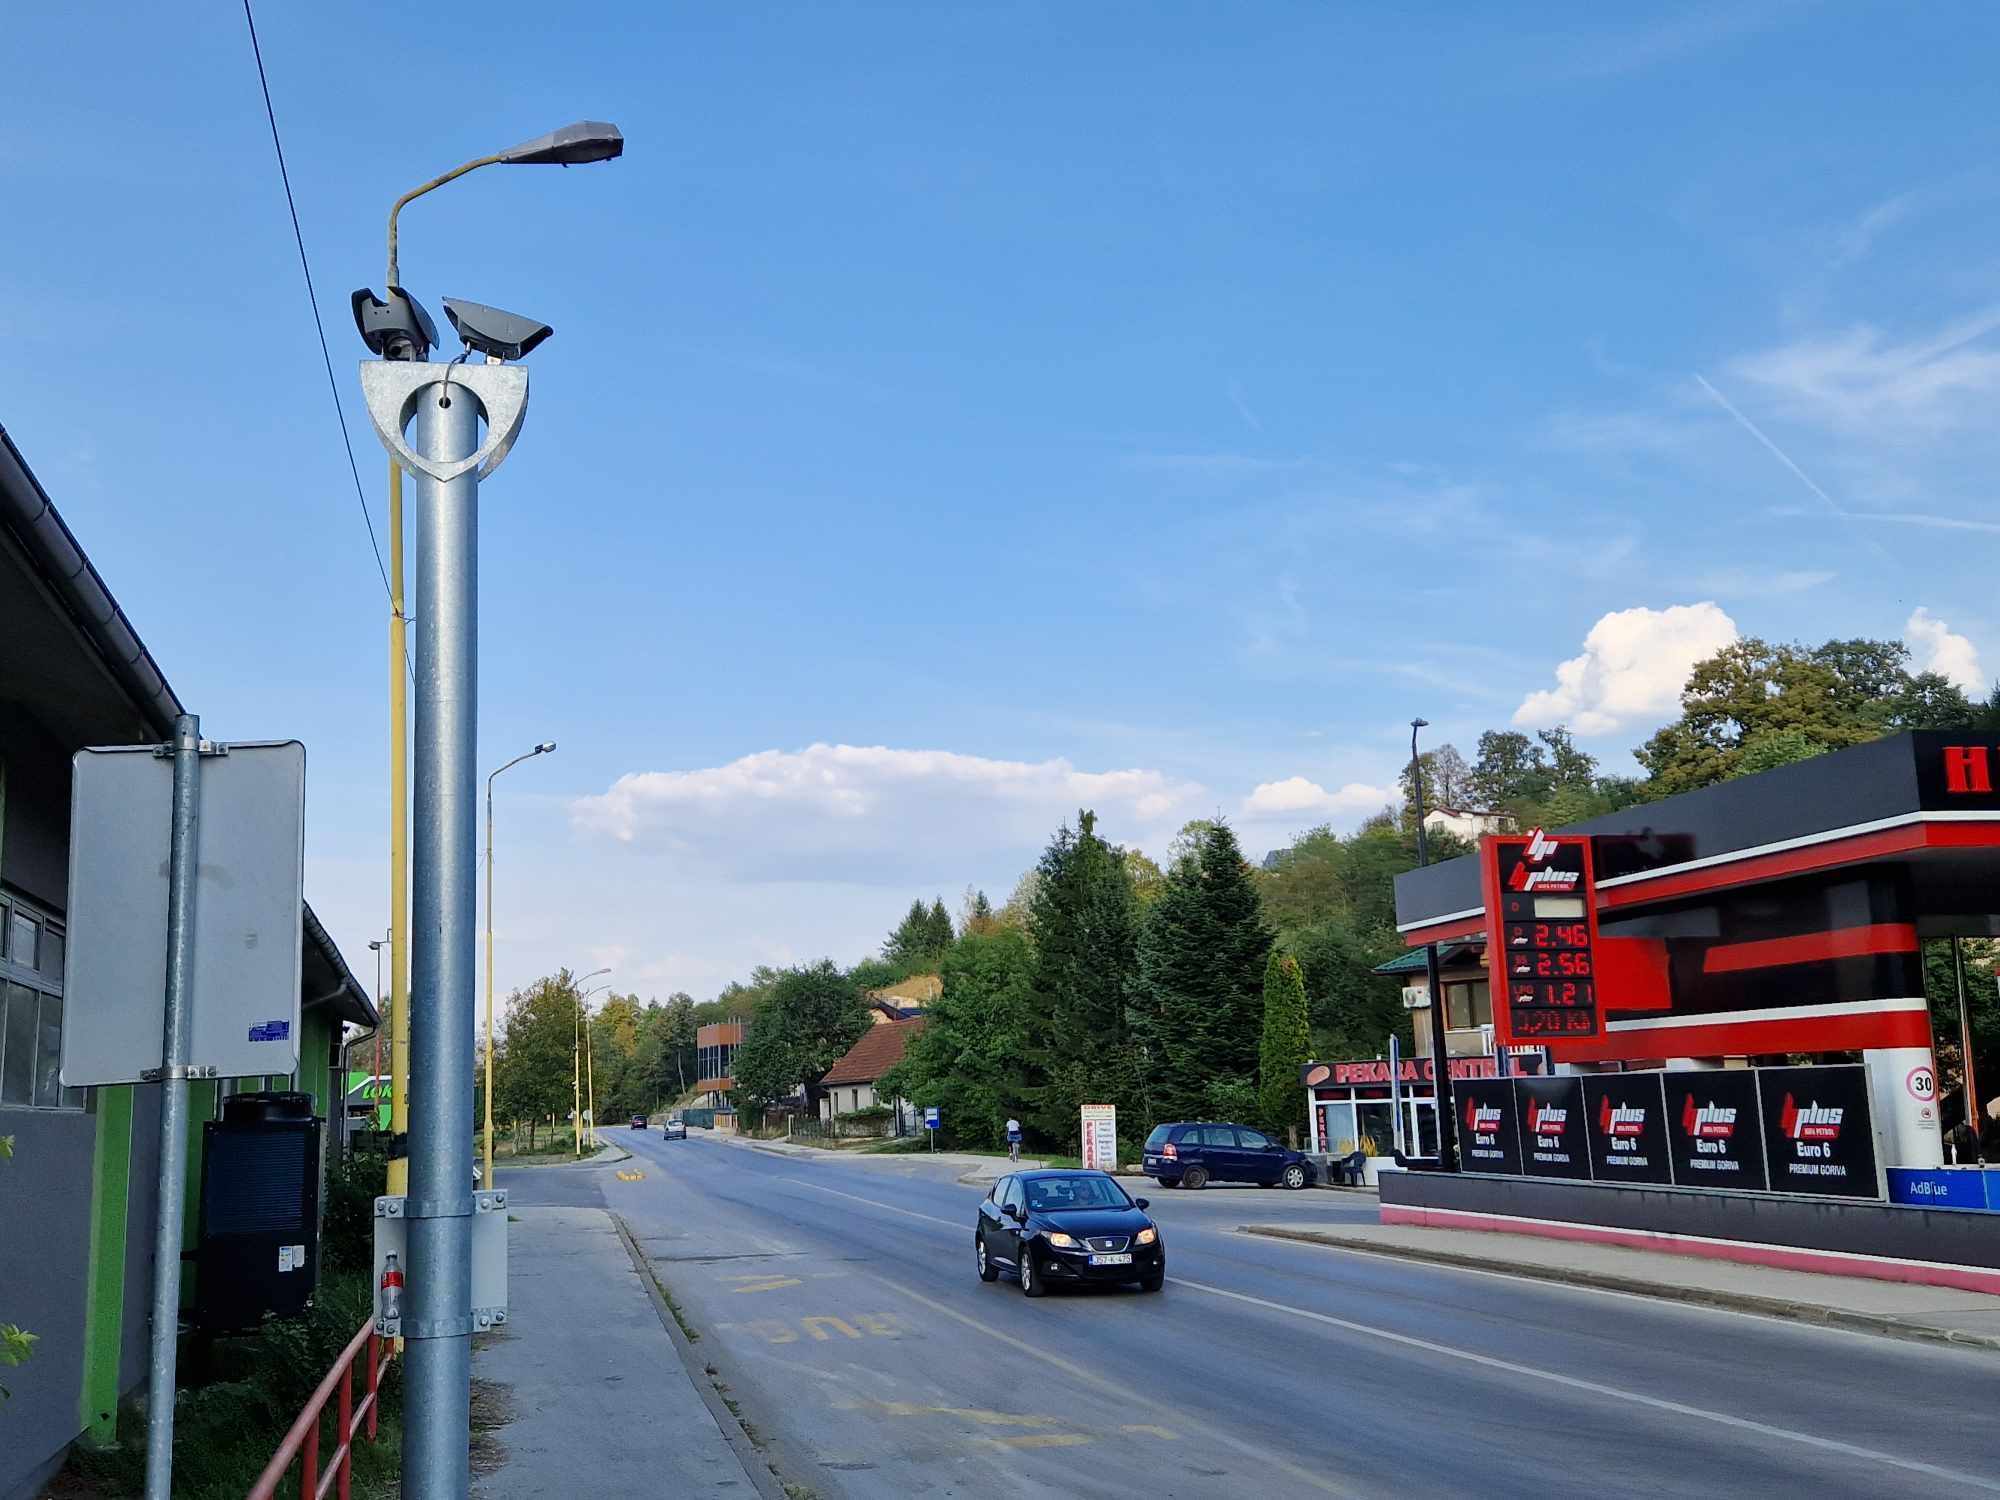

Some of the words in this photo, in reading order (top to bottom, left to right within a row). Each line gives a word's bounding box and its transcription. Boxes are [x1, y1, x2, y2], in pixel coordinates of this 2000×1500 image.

[1535, 924, 1588, 948] 2.46
[1537, 952, 1590, 976] 2.56
[1915, 1076, 1932, 1092] 30
[1611, 1137, 1630, 1150] Euro
[1630, 1138, 1637, 1151] 6
[1696, 1139, 1718, 1153] Euro
[1719, 1139, 1727, 1154] 6
[1796, 1141, 1821, 1157] Euro
[1823, 1141, 1831, 1158] 6
[1789, 1163, 1819, 1174] PREMIUM
[1820, 1164, 1847, 1177] GORIVA
